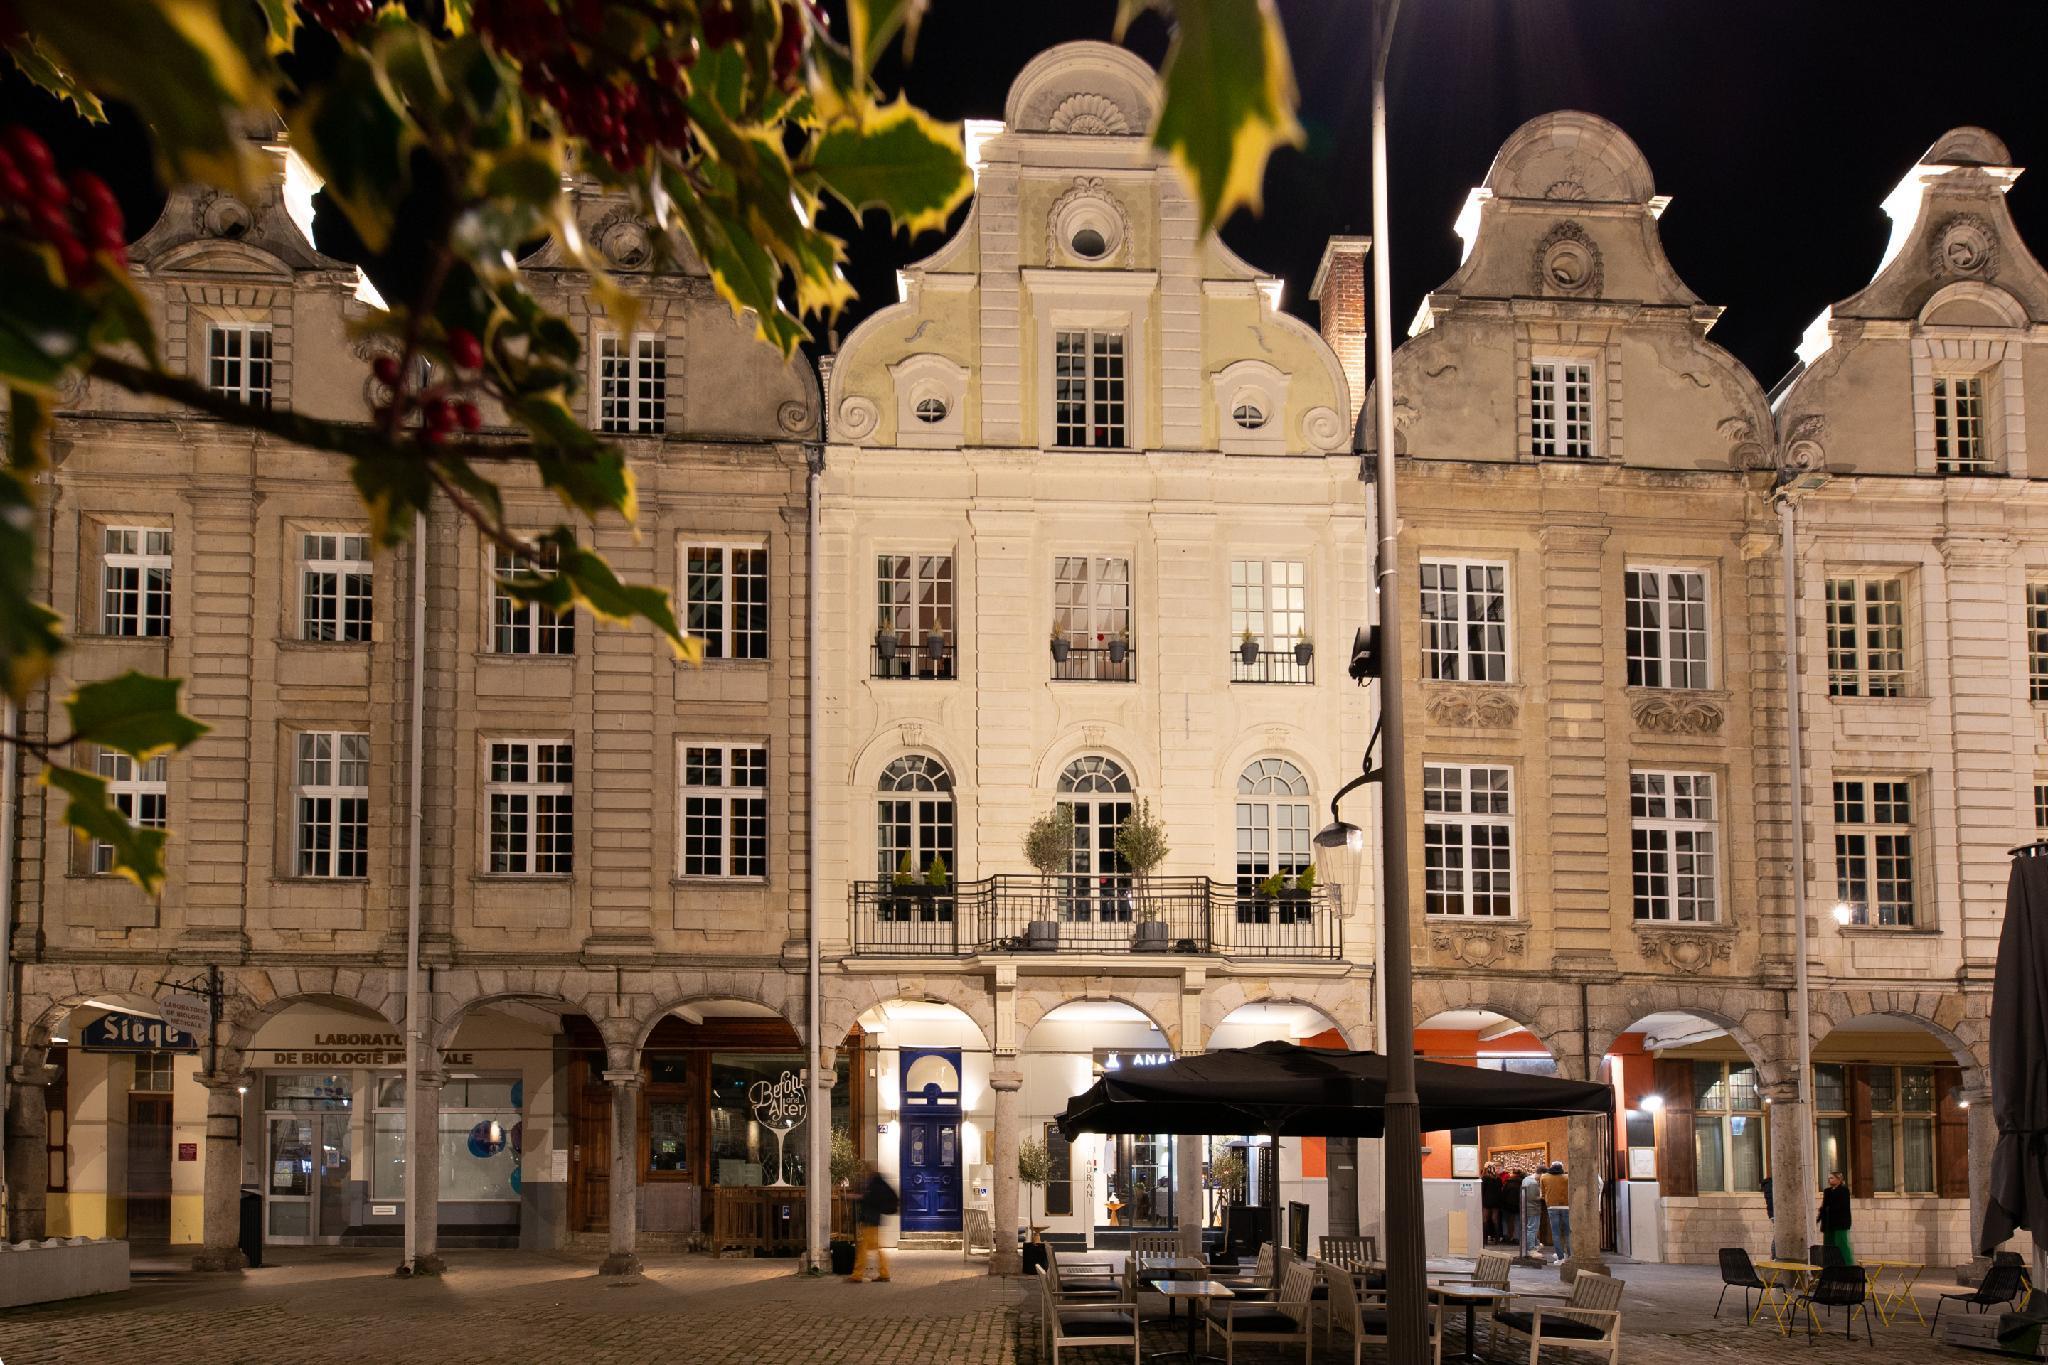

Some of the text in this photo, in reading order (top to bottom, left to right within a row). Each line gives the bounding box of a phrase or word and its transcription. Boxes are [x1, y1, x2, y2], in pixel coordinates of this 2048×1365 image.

[314, 1033, 403, 1046] LABORATO
[274, 1052, 298, 1065] DE
[301, 1052, 384, 1065] BIOLOGIE
